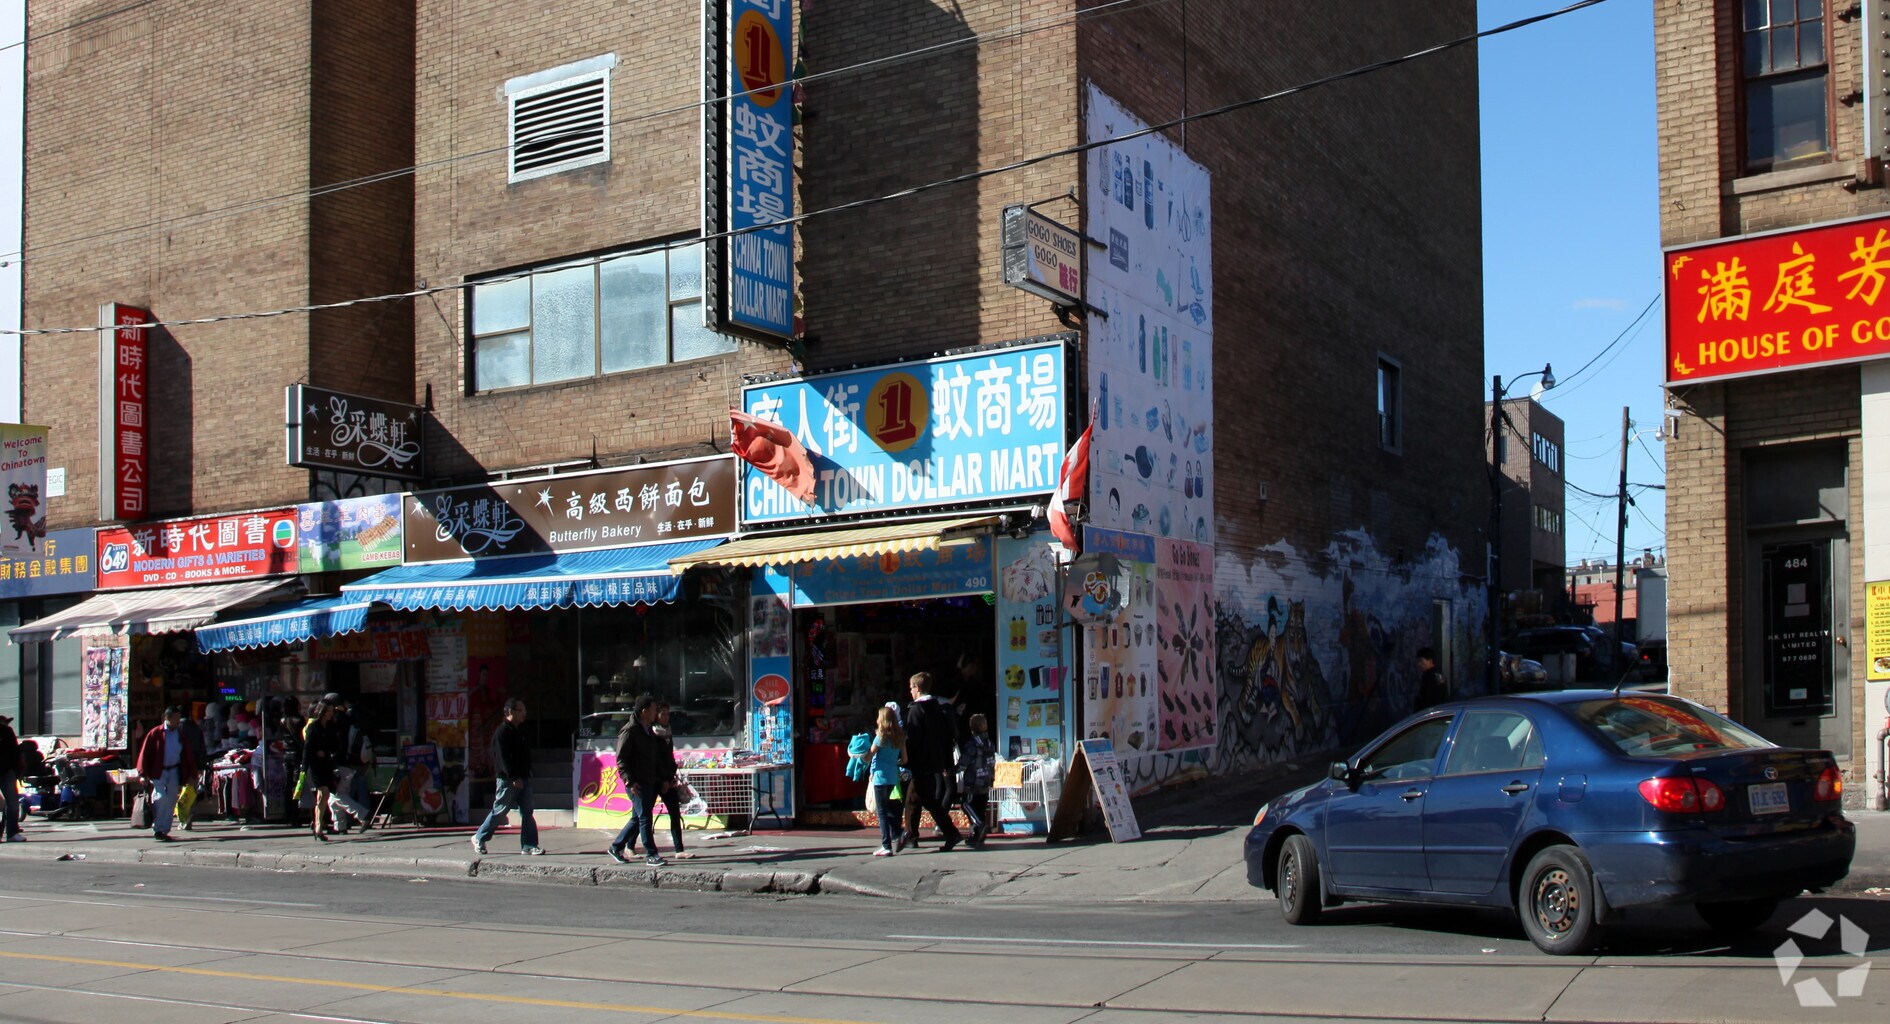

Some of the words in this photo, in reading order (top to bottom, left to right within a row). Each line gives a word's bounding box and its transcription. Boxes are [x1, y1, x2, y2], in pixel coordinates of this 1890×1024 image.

[1028, 219, 1050, 243] GOGO
[1053, 232, 1077, 256] SHOES
[735, 233, 761, 275] CHINA
[763, 239, 788, 283] TOWN
[1034, 244, 1057, 268] GOGO
[1697, 228, 1890, 323] 滿庭芳
[735, 274, 765, 318] DOLLAR
[765, 285, 788, 326] MART
[1698, 331, 1791, 365] HOUSE
[1802, 324, 1839, 350] OF
[119, 314, 143, 512] 新時代圖書公司
[3, 436, 43, 449] Welcome
[18, 449, 28, 459] To
[1, 456, 45, 472] Chinatown
[820, 463, 884, 506] TOWN
[892, 452, 983, 502] DOLLAR
[990, 442, 1058, 491] MART
[566, 476, 710, 520] 高級西餅面包
[131, 514, 270, 557] 新時代圖書
[549, 526, 598, 543] Butterfly
[601, 524, 641, 540] Bakery
[134, 558, 175, 572] MODERN
[178, 555, 205, 569] GIFTS
[206, 554, 213, 565] &
[215, 549, 266, 564] VARIETIES
[362, 553, 379, 562] LAMB
[380, 550, 400, 560] KEBAB
[1784, 558, 1808, 569] 484
[143, 573, 159, 583] DVD
[166, 572, 177, 581] CD
[185, 569, 212, 579] BOOKS
[214, 568, 221, 577] &
[964, 576, 987, 588] 490
[1781, 641, 1817, 649] LIMITED
[1783, 632, 1796, 640] SIT
[1799, 629, 1829, 639] REALTY
